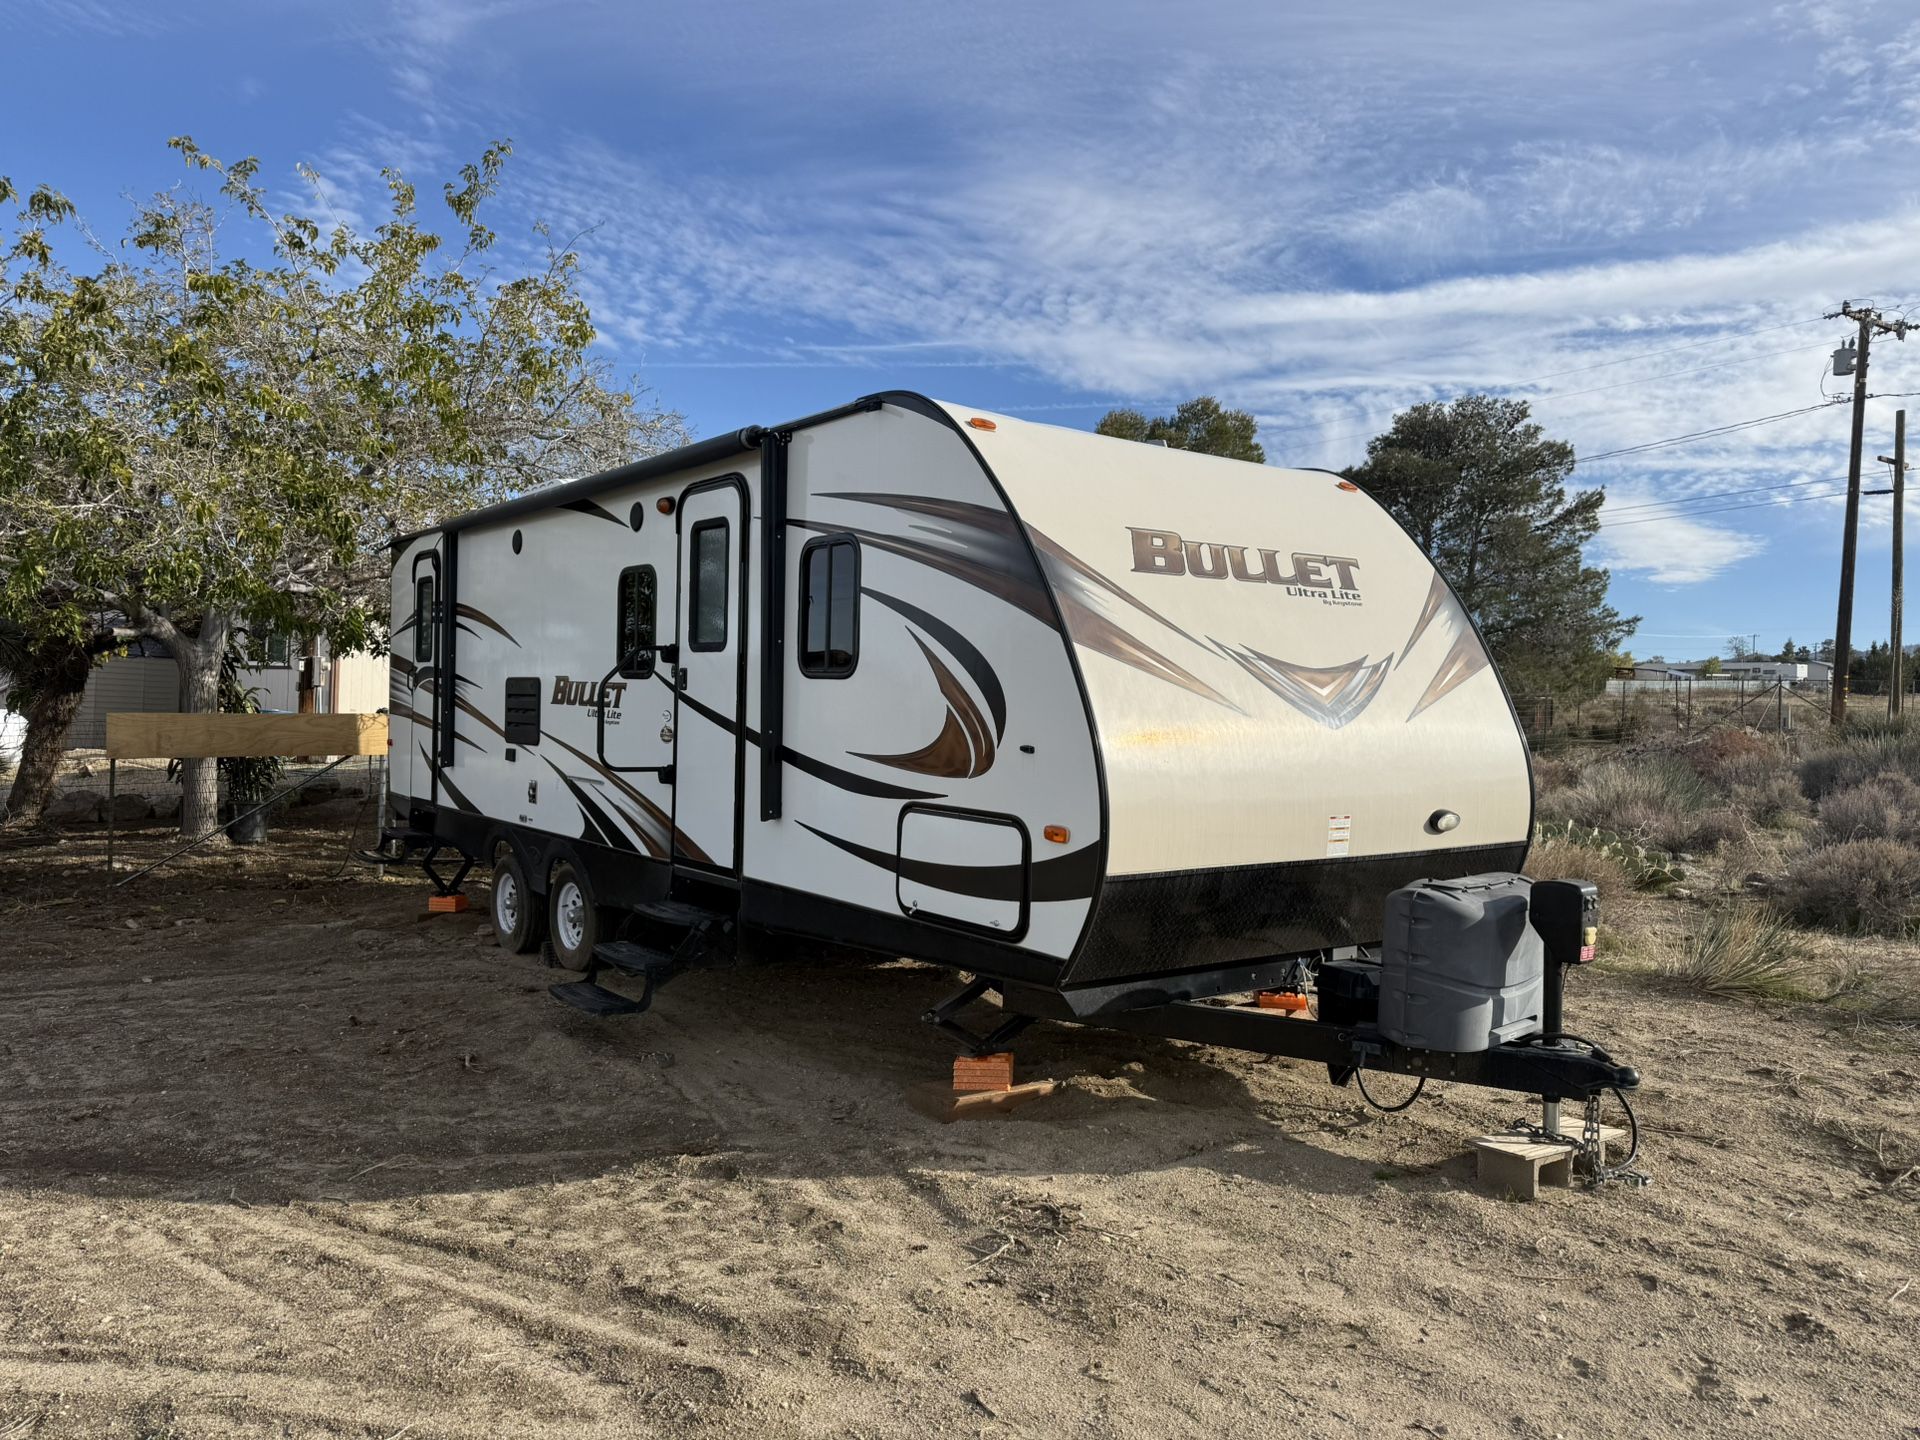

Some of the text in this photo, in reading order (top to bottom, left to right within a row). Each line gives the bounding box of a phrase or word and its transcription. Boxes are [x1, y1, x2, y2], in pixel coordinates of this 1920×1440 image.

[1125, 526, 1360, 590] BULLET
[1286, 586, 1361, 601] Ultra Lite
[551, 676, 627, 708] BULLET
[606, 709, 622, 720] Lite
